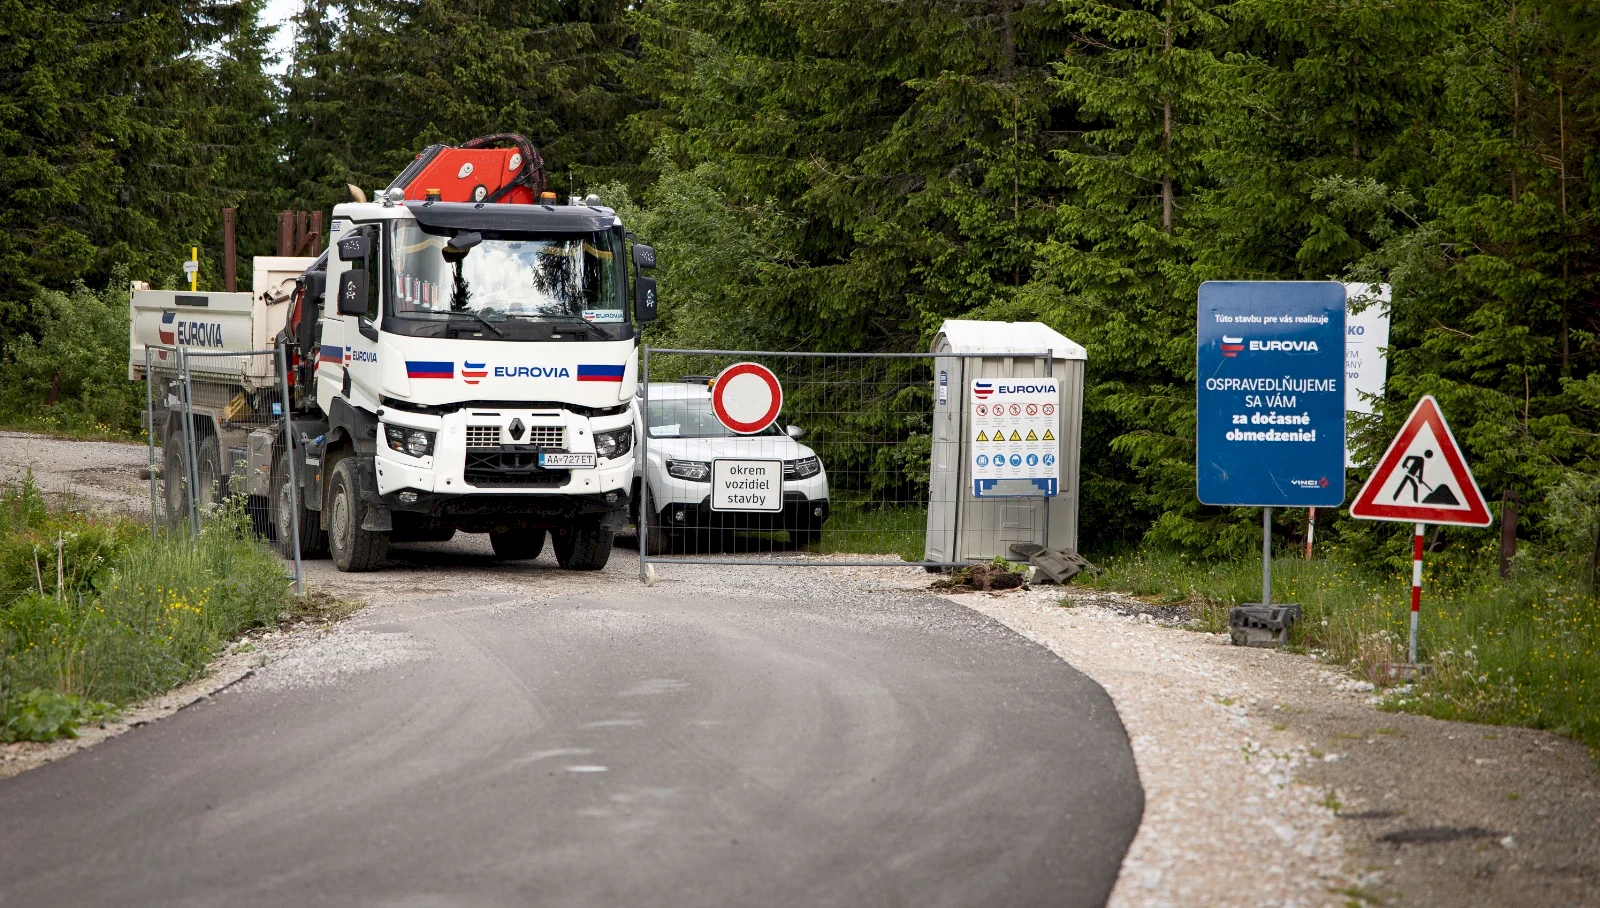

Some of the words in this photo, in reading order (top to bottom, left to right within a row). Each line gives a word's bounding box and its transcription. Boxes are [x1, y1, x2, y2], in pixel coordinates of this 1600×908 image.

[1215, 313, 1233, 323] Túto
[1235, 314, 1262, 323] stavbu
[1264, 316, 1277, 325] pre
[1279, 313, 1293, 323] vás
[1295, 314, 1329, 325] realizuje
[177, 321, 224, 348] EUROVIA
[1249, 340, 1319, 352] EUROVIA
[352, 350, 378, 363] EUROVIA
[494, 366, 570, 378] EUROVIA
[998, 385, 1057, 394] EUROVIA
[1206, 376, 1337, 393] OSPRAVEDLŇUJEME
[1245, 395, 1263, 408] SA
[1266, 393, 1296, 408] VÁM
[1232, 415, 1248, 425] za
[1251, 411, 1311, 425] dočasné
[1225, 428, 1316, 442] obmedzenie!
[730, 465, 766, 475] okrem
[725, 478, 769, 490] vozidiel
[727, 493, 766, 506] stavby
